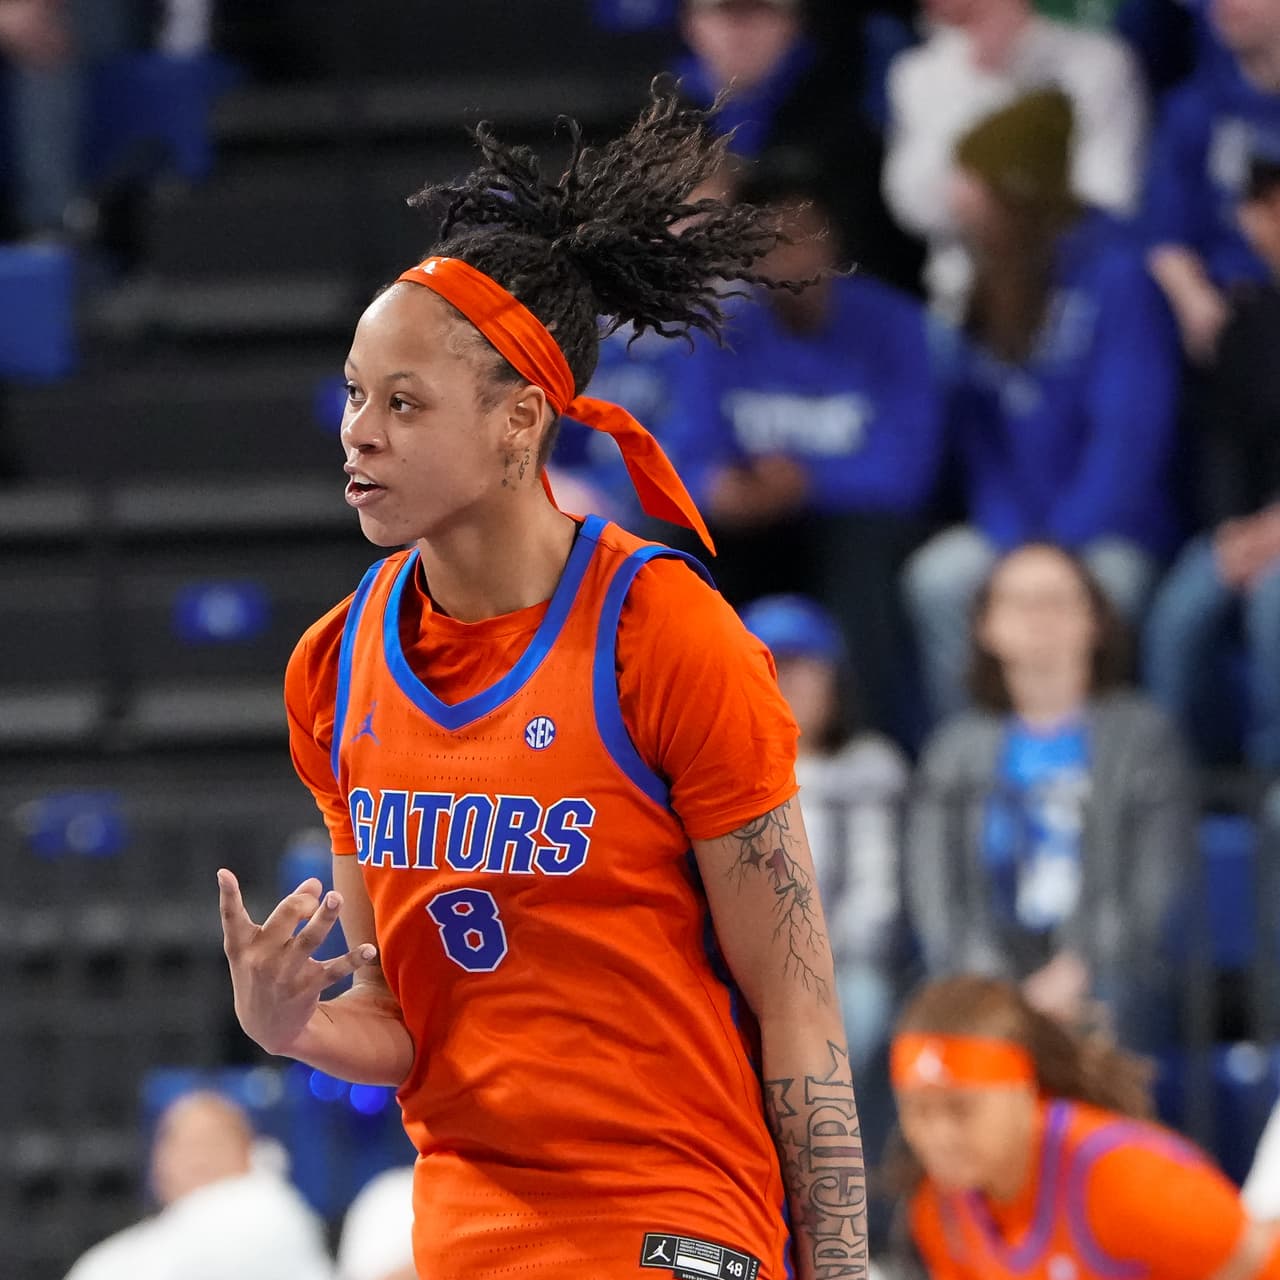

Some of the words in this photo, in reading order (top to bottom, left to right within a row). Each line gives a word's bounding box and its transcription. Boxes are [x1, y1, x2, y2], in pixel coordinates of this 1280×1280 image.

[525, 717, 555, 749] SEC
[348, 787, 597, 876] GATORS
[425, 888, 508, 973] 8
[726, 1259, 743, 1278] 48
